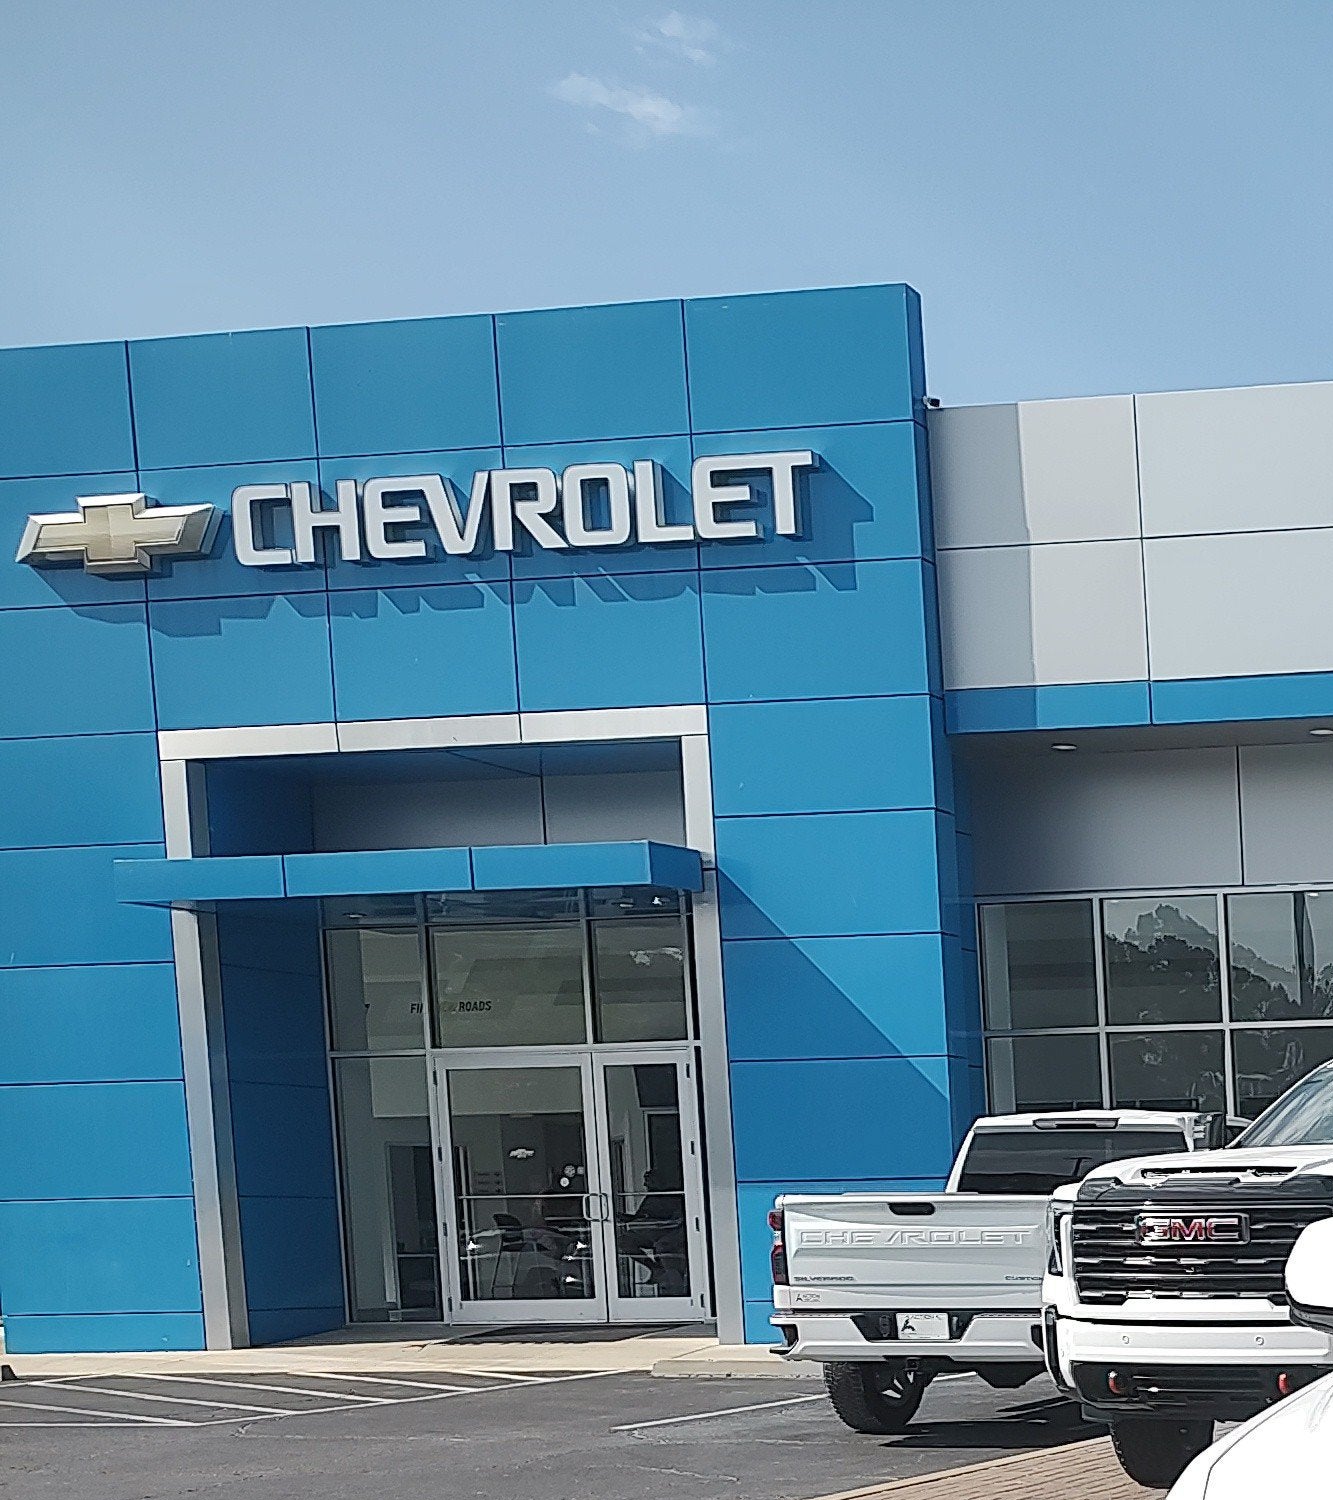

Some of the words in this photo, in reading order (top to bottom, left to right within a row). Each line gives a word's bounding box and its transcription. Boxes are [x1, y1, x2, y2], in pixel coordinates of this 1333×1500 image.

[231, 450, 822, 567] CHEVROLET
[459, 1001, 492, 1012] ROADS
[1139, 1218, 1239, 1241] GMC
